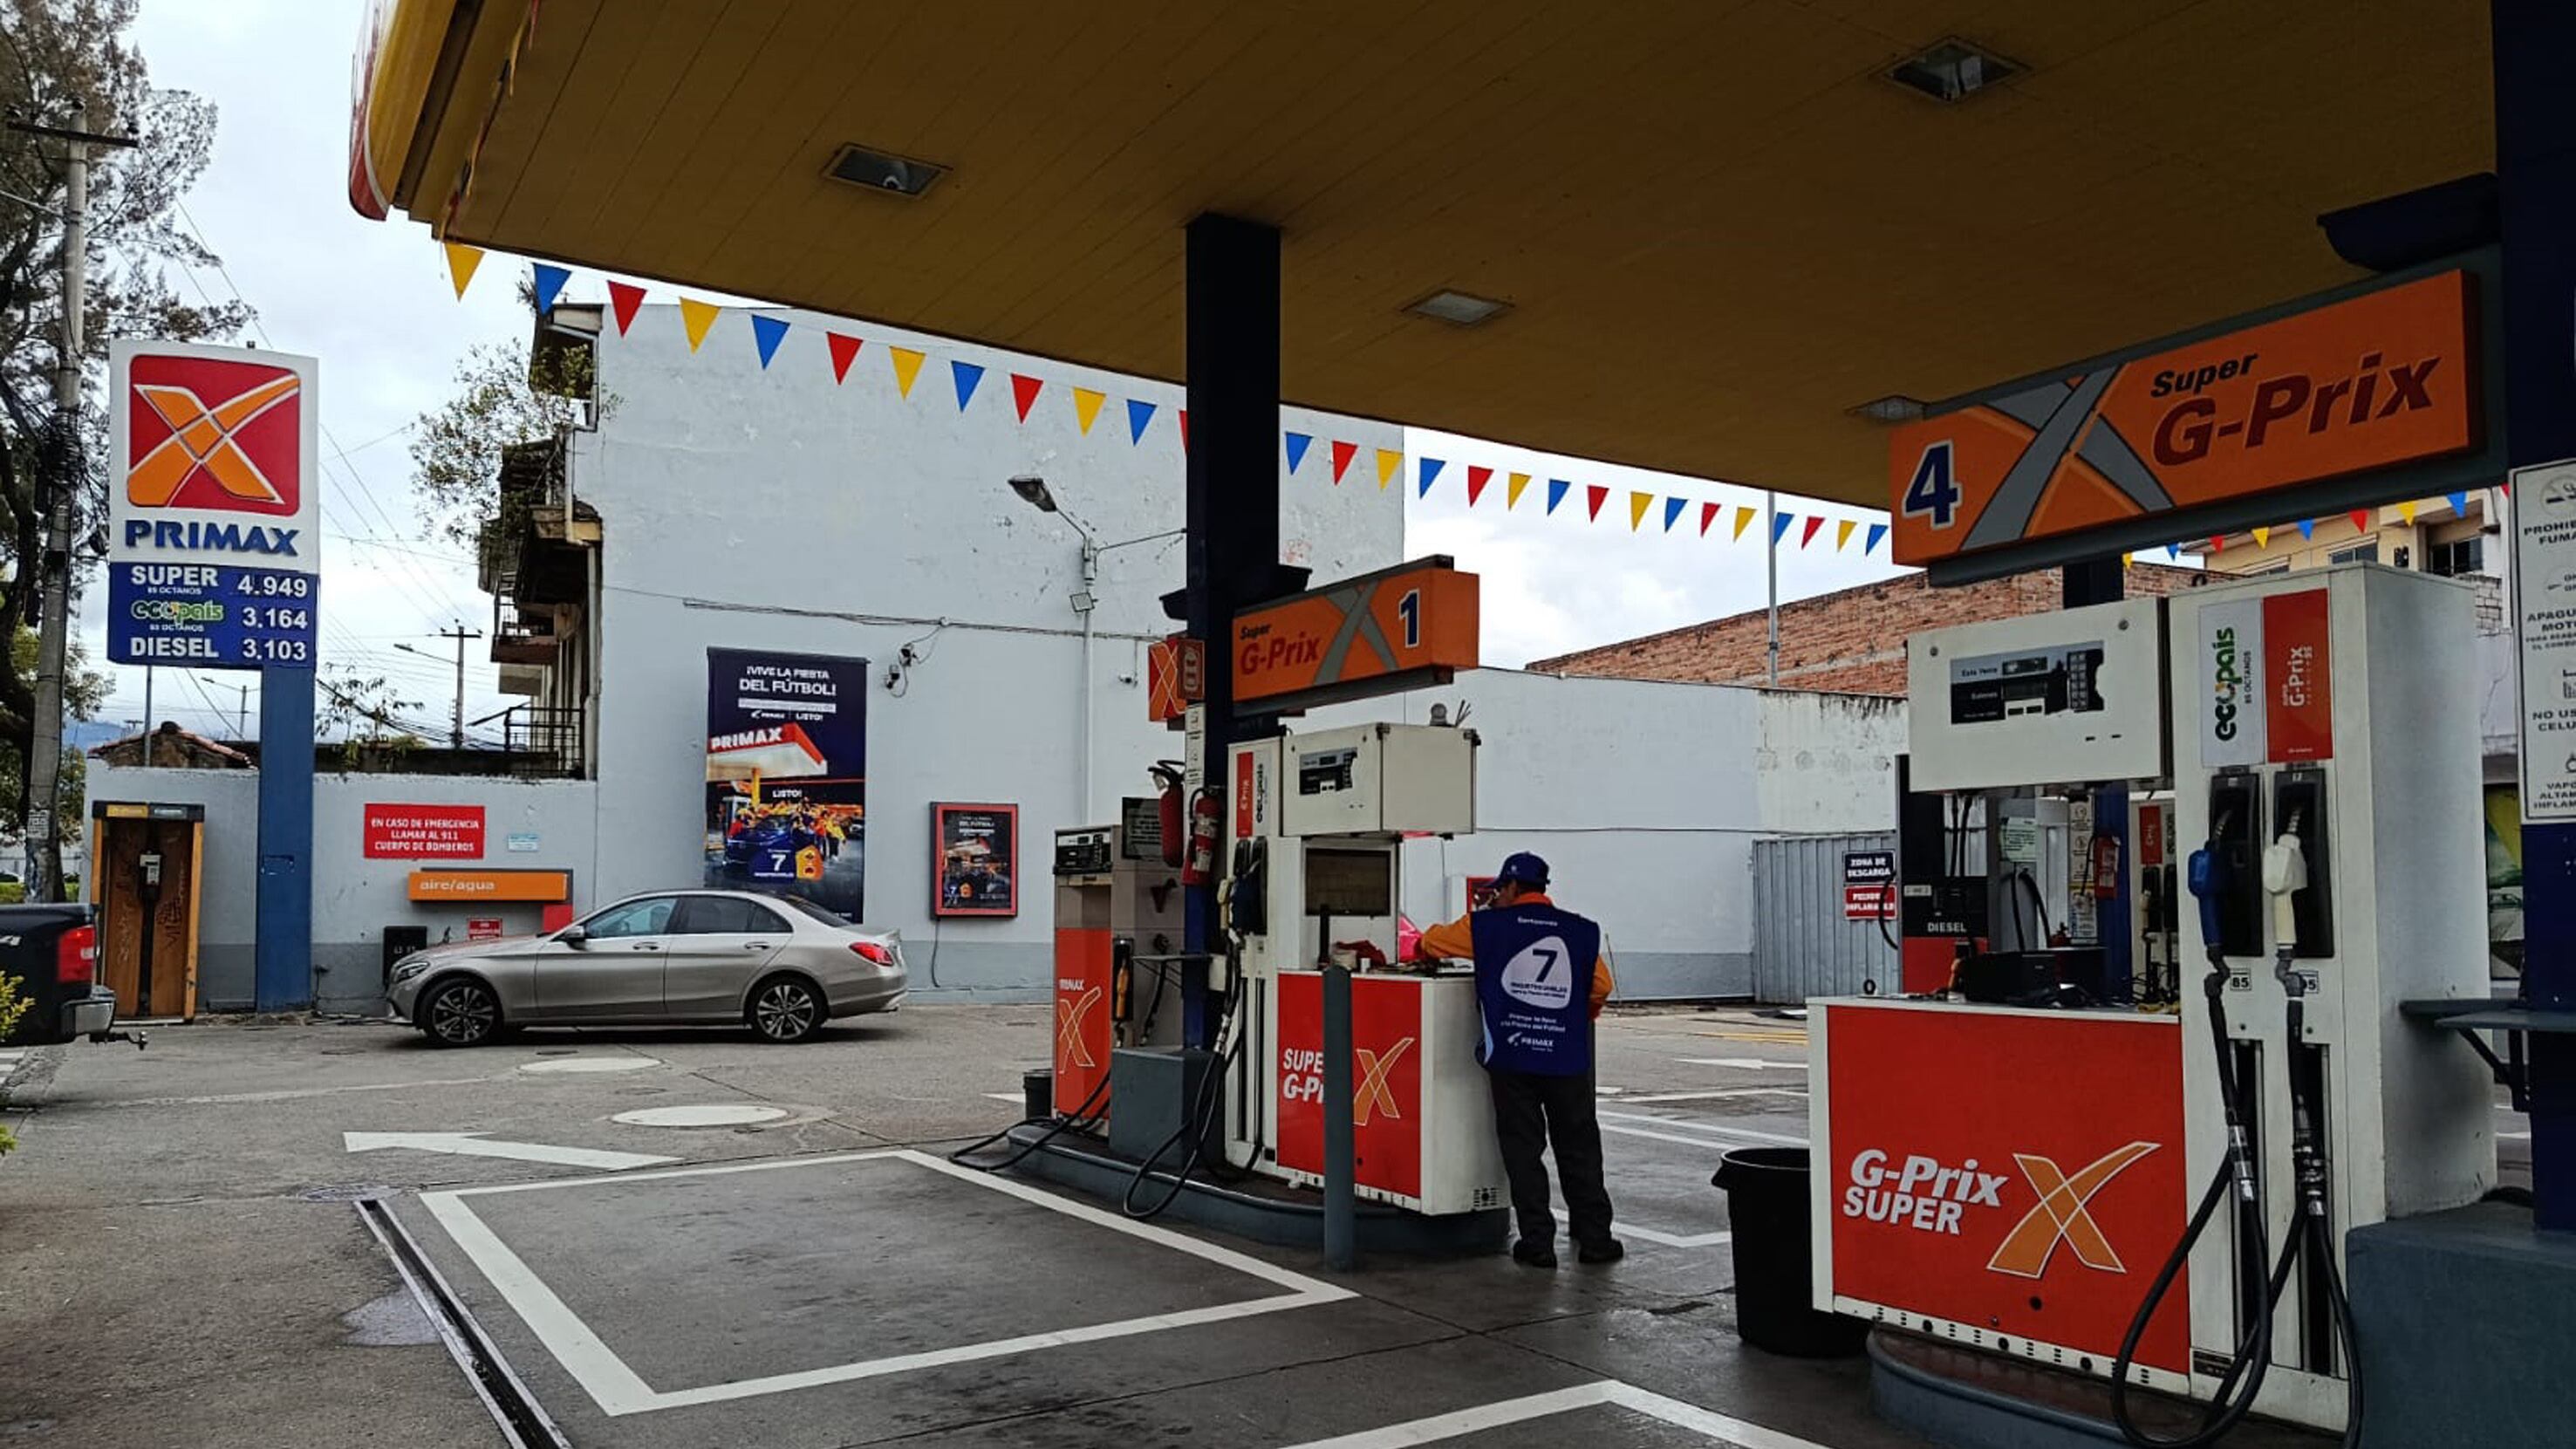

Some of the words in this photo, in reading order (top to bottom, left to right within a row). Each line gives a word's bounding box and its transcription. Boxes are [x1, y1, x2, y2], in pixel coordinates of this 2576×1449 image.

[2150, 352, 2258, 399] Super
[2153, 351, 2441, 467] G-Prix
[1902, 440, 1962, 530] 4
[125, 519, 299, 557] PRIMAX
[132, 565, 218, 586] SUPER
[237, 575, 307, 598] 4.949
[161, 624, 204, 632] OCTANOS
[243, 607, 307, 629] 3.164
[1398, 588, 1420, 648] 1
[2542, 620, 2576, 632] MOT
[1240, 623, 1272, 641] Super
[131, 637, 219, 658] DIESEL
[243, 639, 307, 660] 3.103
[1240, 631, 1322, 675] G-Prix
[776, 668, 791, 677] LA
[794, 668, 830, 679] FIESTA
[2243, 650, 2251, 693] OCTANOS
[2286, 646, 2305, 707] G-Prix
[739, 678, 769, 692] DEL
[2532, 710, 2553, 721] NO
[711, 728, 783, 750] PRIMAX
[371, 817, 384, 828] EN
[386, 817, 409, 828] CASO
[410, 818, 422, 829] DE
[424, 819, 479, 830] EMERGENCIA
[374, 841, 411, 851] CUERPO
[412, 842, 424, 851] DE
[426, 842, 475, 851] BOMBEROS
[390, 830, 427, 839] LLAMAR
[427, 830, 439, 840] AL
[441, 830, 458, 840] 911
[772, 853, 786, 871] 7
[1850, 858, 1873, 866] ZONA
[1875, 857, 1886, 865] DE
[420, 879, 495, 892] aire/agua
[1927, 922, 1967, 933] DIESEL
[1533, 948, 1558, 983] 7
[1283, 1047, 1324, 1074] SUPE
[1283, 1073, 1324, 1104] G-Pr
[1850, 1149, 2011, 1207] G-Prix
[1842, 1186, 1963, 1235] SUPER
